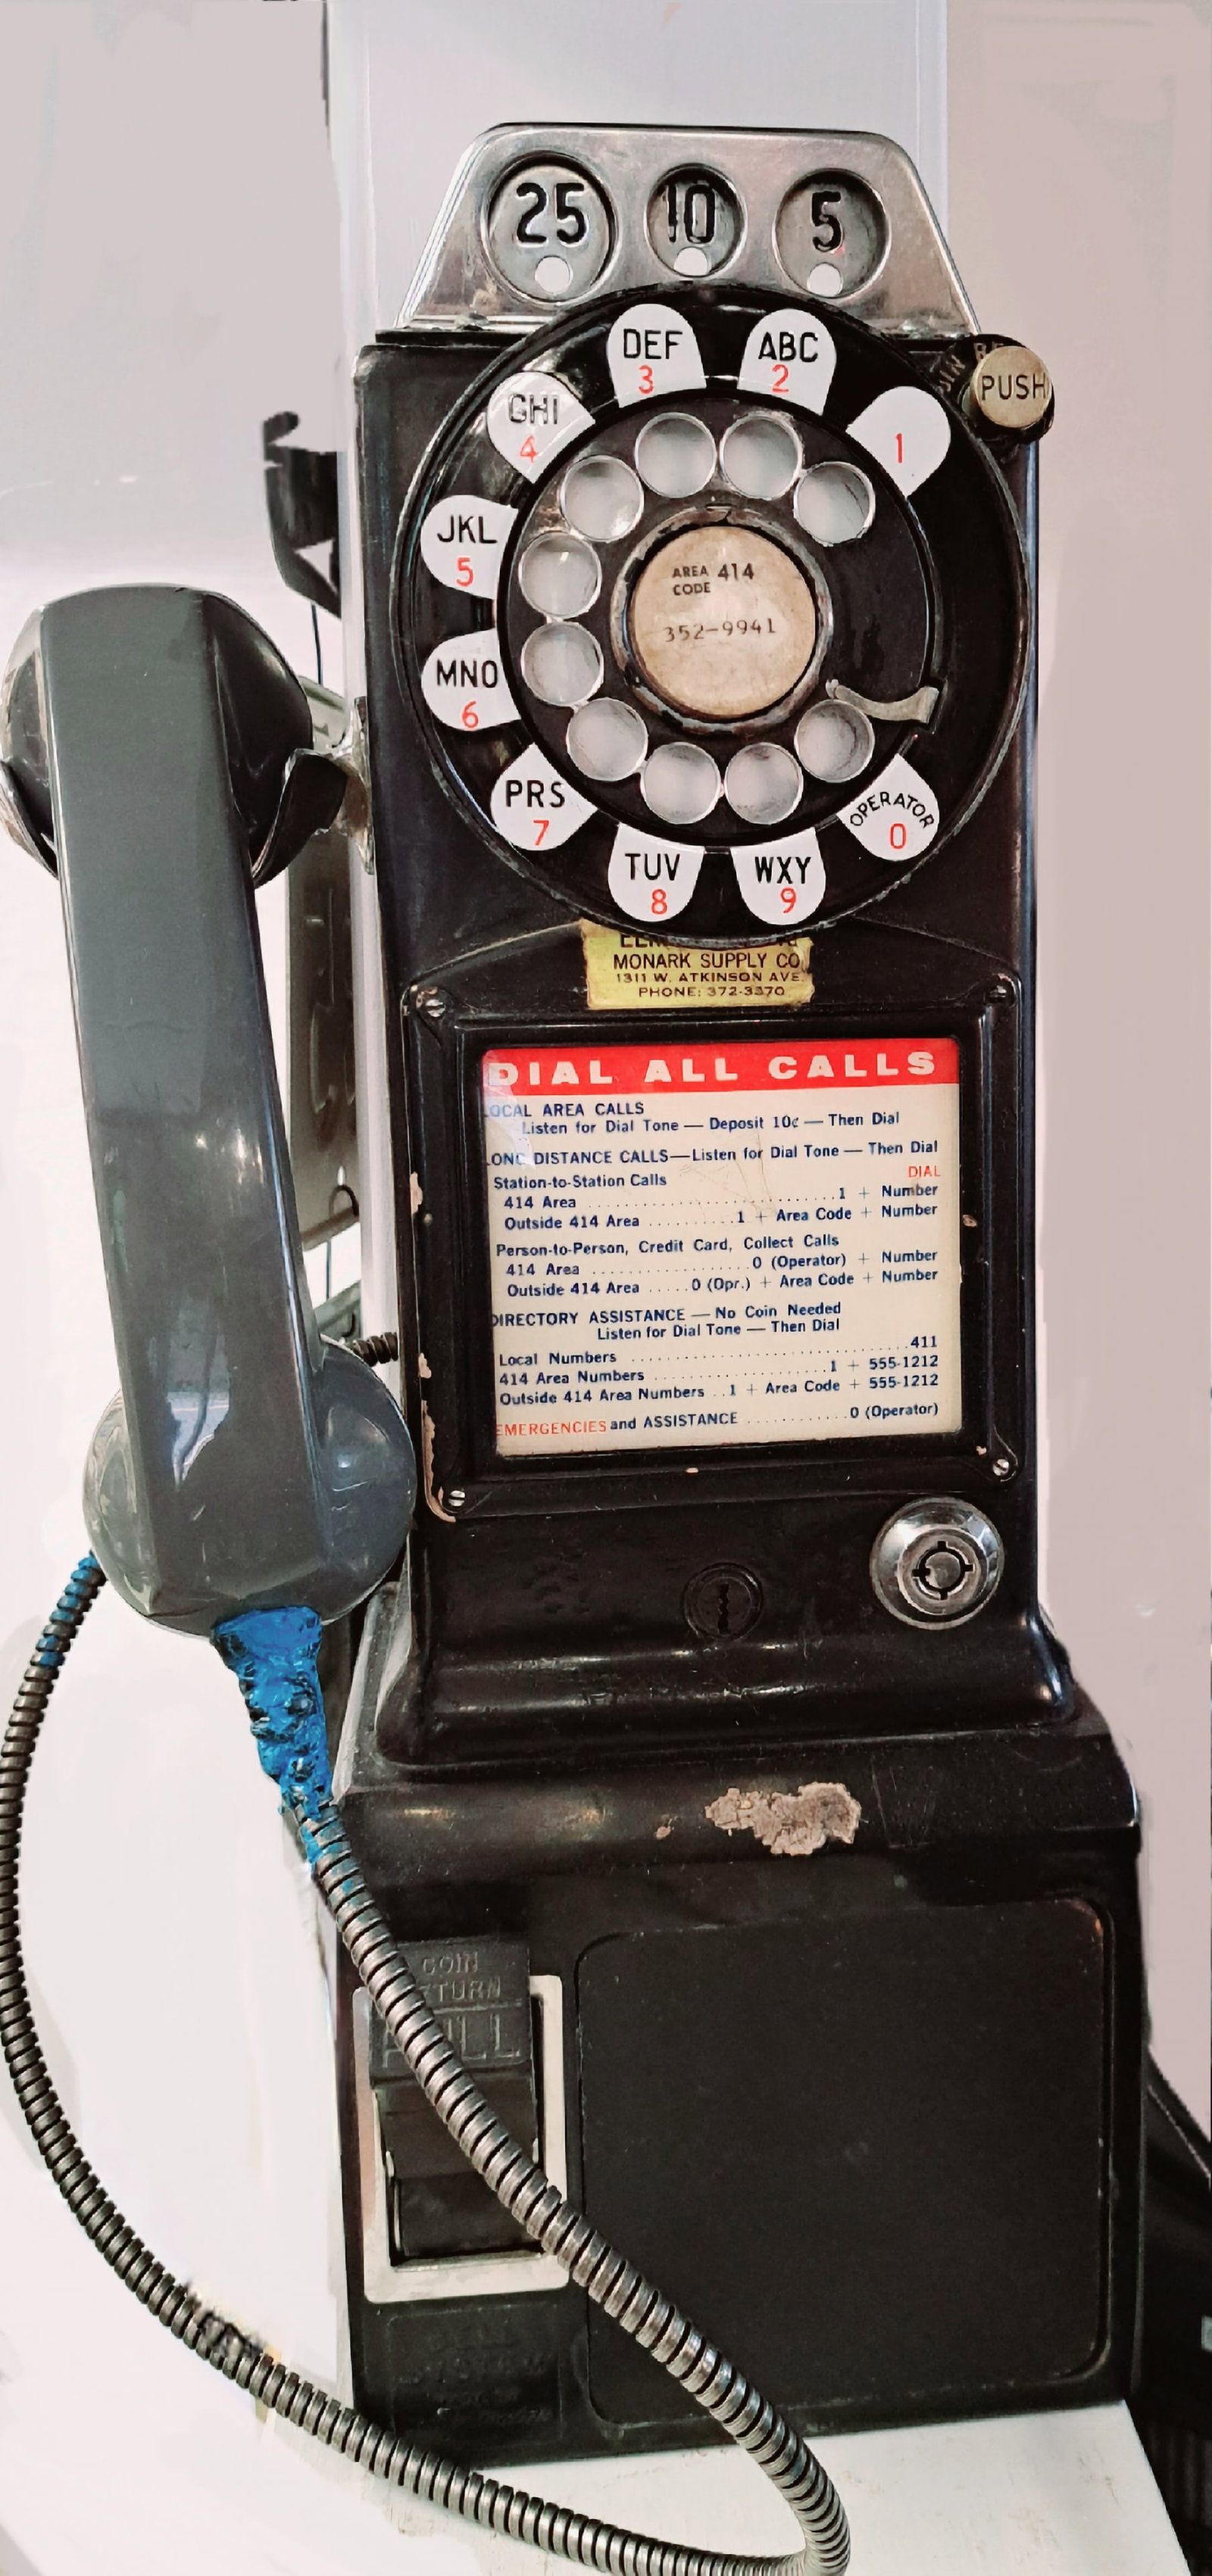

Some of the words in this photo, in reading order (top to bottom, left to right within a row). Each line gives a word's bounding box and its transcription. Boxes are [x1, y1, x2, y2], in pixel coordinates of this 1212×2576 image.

[516, 182, 588, 246] 25
[666, 182, 717, 244] 10
[811, 190, 844, 253] 5
[623, 328, 683, 360] DEF
[758, 332, 818, 362] ABC
[638, 365, 654, 395] 3
[771, 364, 789, 393] 2
[982, 373, 1045, 401] PUSH
[507, 393, 559, 425] GHI
[519, 434, 539, 463] 4
[895, 433, 903, 463] 1
[436, 515, 498, 544] JKL
[456, 557, 473, 587] 5
[672, 565, 709, 579] AREA
[717, 563, 754, 582] 414
[673, 582, 711, 596] CODE
[663, 618, 776, 643] 352-9941
[436, 659, 498, 688] MNO
[461, 700, 479, 728] 6
[505, 780, 565, 808] PRS
[850, 791, 935, 828] OPERATOR
[533, 819, 549, 846] 7
[890, 823, 907, 850] 0
[625, 853, 680, 881] TUV
[754, 856, 811, 884] WXY
[651, 889, 667, 915] 8
[779, 887, 796, 913] 9
[614, 953, 692, 969] MONARK
[700, 953, 767, 968] SUPPLY
[617, 973, 647, 983] 1311
[654, 973, 672, 983] W.
[679, 972, 762, 982] ATKINSON
[639, 987, 701, 998] PHONE:
[488, 1059, 613, 1086] DIAL
[644, 1057, 738, 1082] ALL
[768, 1051, 935, 1080] CALLS
[485, 1103, 532, 1117] OCAL
[542, 1103, 585, 1117] AREA
[595, 1102, 645, 1115] CALLS
[522, 1121, 567, 1134] Listen
[576, 1121, 597, 1134] for
[606, 1119, 634, 1133] Dial
[643, 1119, 679, 1131] Tone
[709, 1117, 764, 1133] Deposit
[829, 1114, 864, 1127] Then
[872, 1112, 899, 1125] Dial
[534, 1151, 612, 1165] DISTANCE
[744, 1146, 764, 1159] for
[771, 1145, 797, 1159] Dial
[804, 1144, 839, 1157] Tone
[868, 1142, 903, 1155] Then
[911, 1140, 938, 1153] Dial
[494, 1175, 625, 1190] Station-to-Station
[630, 1174, 667, 1187] Calls
[908, 1165, 941, 1178] DIAL
[504, 1196, 534, 1209] 414
[542, 1196, 576, 1208] Area
[881, 1184, 939, 1197] Number
[504, 1216, 562, 1230] Outside
[569, 1215, 598, 1228] 414
[606, 1215, 640, 1227] Area
[776, 1209, 808, 1222] Area
[815, 1207, 851, 1220] Code
[881, 1204, 938, 1218] Number
[496, 1242, 629, 1257] Person-to-Person,
[639, 1240, 683, 1253] Credit
[693, 1238, 732, 1252] Card,
[744, 1236, 793, 1249] Collect
[804, 1233, 839, 1247] Calls
[506, 1264, 535, 1276] 414
[545, 1263, 579, 1275] Area
[771, 1253, 847, 1271] (Operator)
[882, 1249, 938, 1264] Number
[508, 1283, 564, 1297] Outside
[570, 1282, 600, 1295] 414
[606, 1281, 640, 1293] Area
[708, 1277, 751, 1293] (Opr.)
[779, 1274, 812, 1288] Area
[818, 1272, 854, 1286] Code
[882, 1269, 938, 1283] Number
[492, 1312, 578, 1327] DIRECTORY
[589, 1308, 686, 1324] ASSISTANCE
[716, 1307, 736, 1319] No
[745, 1305, 776, 1318] Coin
[788, 1302, 841, 1316] Needed
[598, 1327, 641, 1340] Listen
[646, 1326, 667, 1338] for
[673, 1324, 700, 1337] Dial
[706, 1324, 741, 1336] Tone
[771, 1321, 805, 1333] Then
[812, 1318, 839, 1331] Dial
[499, 1353, 537, 1367] Local
[549, 1352, 617, 1364] Numbers
[911, 1336, 937, 1348] 411
[500, 1373, 528, 1385] 414
[536, 1371, 569, 1384] Area
[578, 1371, 645, 1383] Numbers
[869, 1355, 939, 1369] 555-1212
[500, 1392, 557, 1406] Outside
[564, 1391, 592, 1403] 414
[599, 1389, 633, 1402] Area
[639, 1387, 704, 1401] Numbers
[765, 1382, 797, 1394] Area
[804, 1380, 840, 1392] Code
[869, 1374, 939, 1389] 555-1212
[495, 1421, 606, 1436] EMERGENCIES
[611, 1417, 636, 1430] and
[644, 1412, 738, 1429] ASSISTANCE
[865, 1402, 939, 1420] (Operator)
[423, 1951, 479, 1976] COIN
